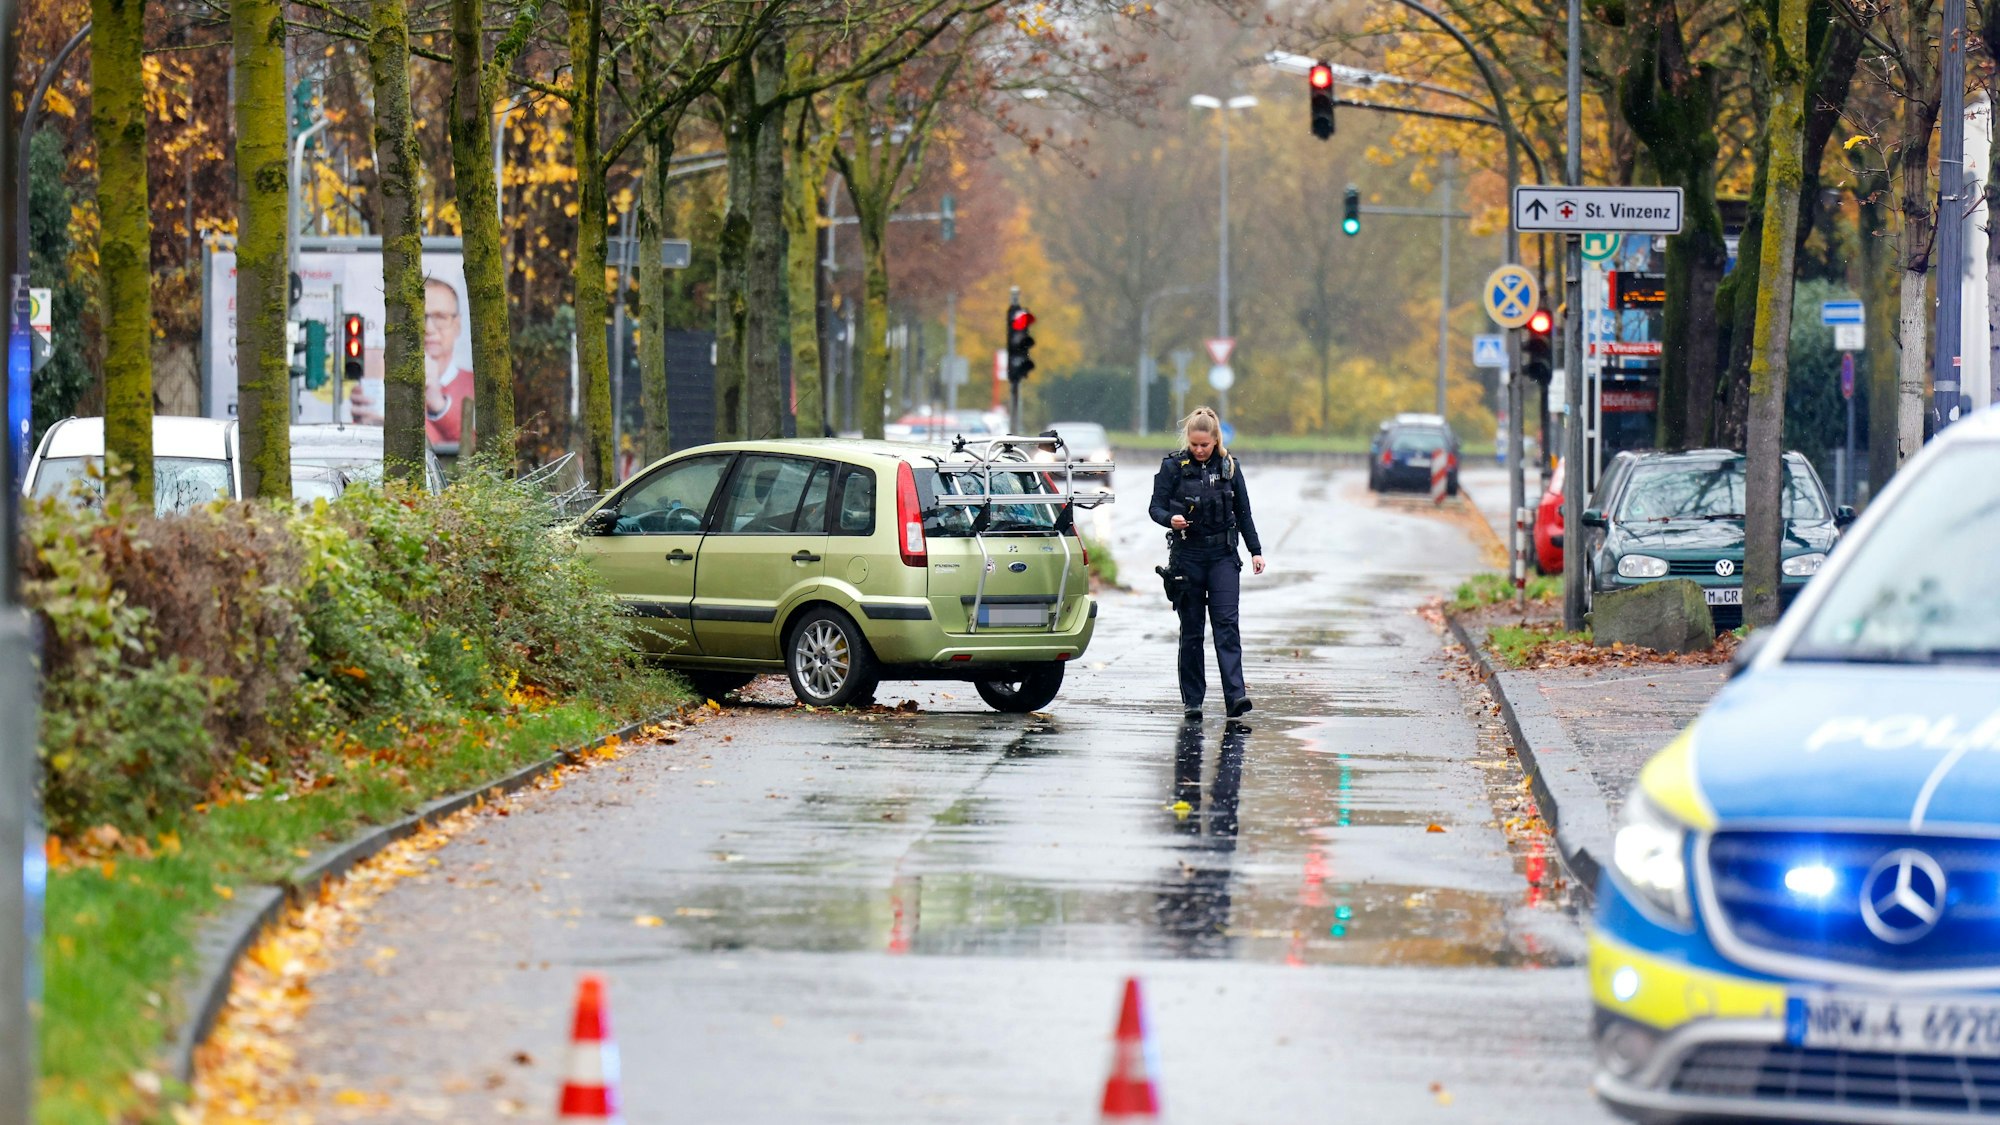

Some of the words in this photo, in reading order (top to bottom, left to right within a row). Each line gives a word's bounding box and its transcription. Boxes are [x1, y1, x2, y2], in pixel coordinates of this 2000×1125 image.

[1585, 202, 1605, 218] St.
[1610, 203, 1671, 219] Vinzenz
[1724, 590, 1738, 603] CR
